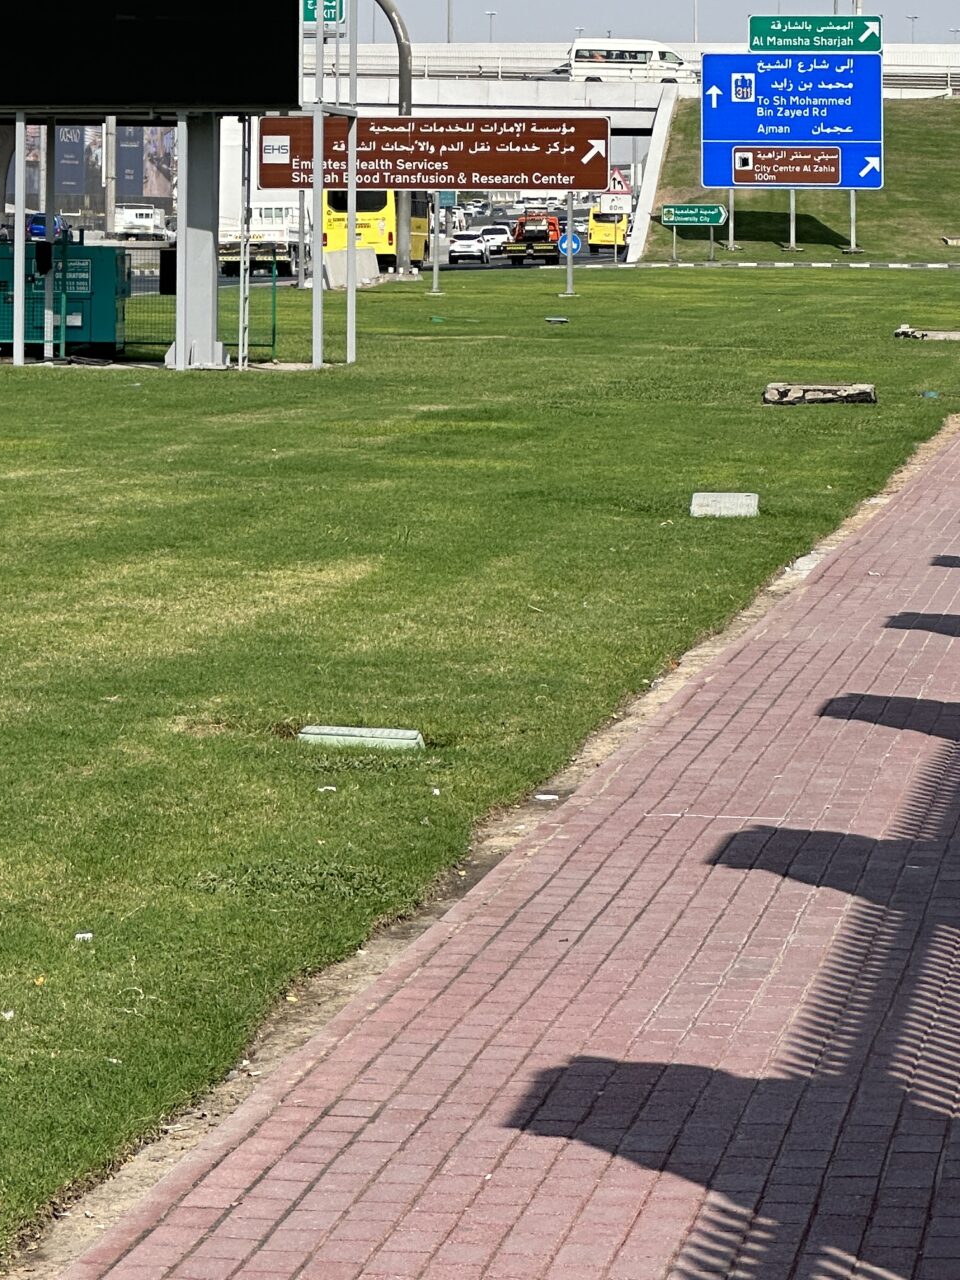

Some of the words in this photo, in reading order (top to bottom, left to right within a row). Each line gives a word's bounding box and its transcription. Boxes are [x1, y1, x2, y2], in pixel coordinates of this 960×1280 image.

[770, 21, 812, 32] بالشارقة
[816, 21, 854, 33] الممشى
[752, 36, 764, 46] Al
[766, 36, 810, 46] Mamsha
[813, 35, 854, 47] Sharjah
[756, 58, 792, 73] الشيخ
[797, 58, 829, 73] شارع
[835, 58, 854, 73] إلى
[770, 78, 794, 91] زايد
[798, 81, 813, 91] بن
[817, 79, 854, 89] محمد
[736, 87, 751, 98] 311
[756, 96, 770, 106] To
[773, 96, 787, 106] Sh
[790, 96, 852, 106] Mohammed
[756, 107, 774, 117] Bin
[776, 107, 810, 118] Zayed
[812, 107, 828, 117] Rd
[368, 122, 415, 134] الصحية
[419, 122, 475, 133] للخدمات
[480, 122, 526, 137] الإمارات
[530, 122, 576, 135] مؤسسة
[757, 123, 791, 134] Ajman
[811, 122, 854, 135] عجمان
[263, 144, 289, 155] EHS
[380, 139, 435, 154] والأبحاث
[439, 141, 464, 157] الدم
[468, 141, 491, 154] نقل
[495, 141, 541, 153] خدمات
[545, 141, 576, 154] مركز
[789, 151, 812, 161] سنتر
[813, 151, 839, 162] سيتي
[396, 158, 449, 170] Services
[754, 164, 771, 174] City
[773, 164, 801, 173] Centre
[802, 164, 812, 172] Al
[813, 164, 836, 173] Zahia
[291, 171, 339, 183] Shaah
[382, 172, 455, 184] Transfusion
[457, 172, 467, 184] &
[472, 172, 529, 184] Research
[532, 172, 576, 184] Center
[754, 173, 777, 181] 100m
